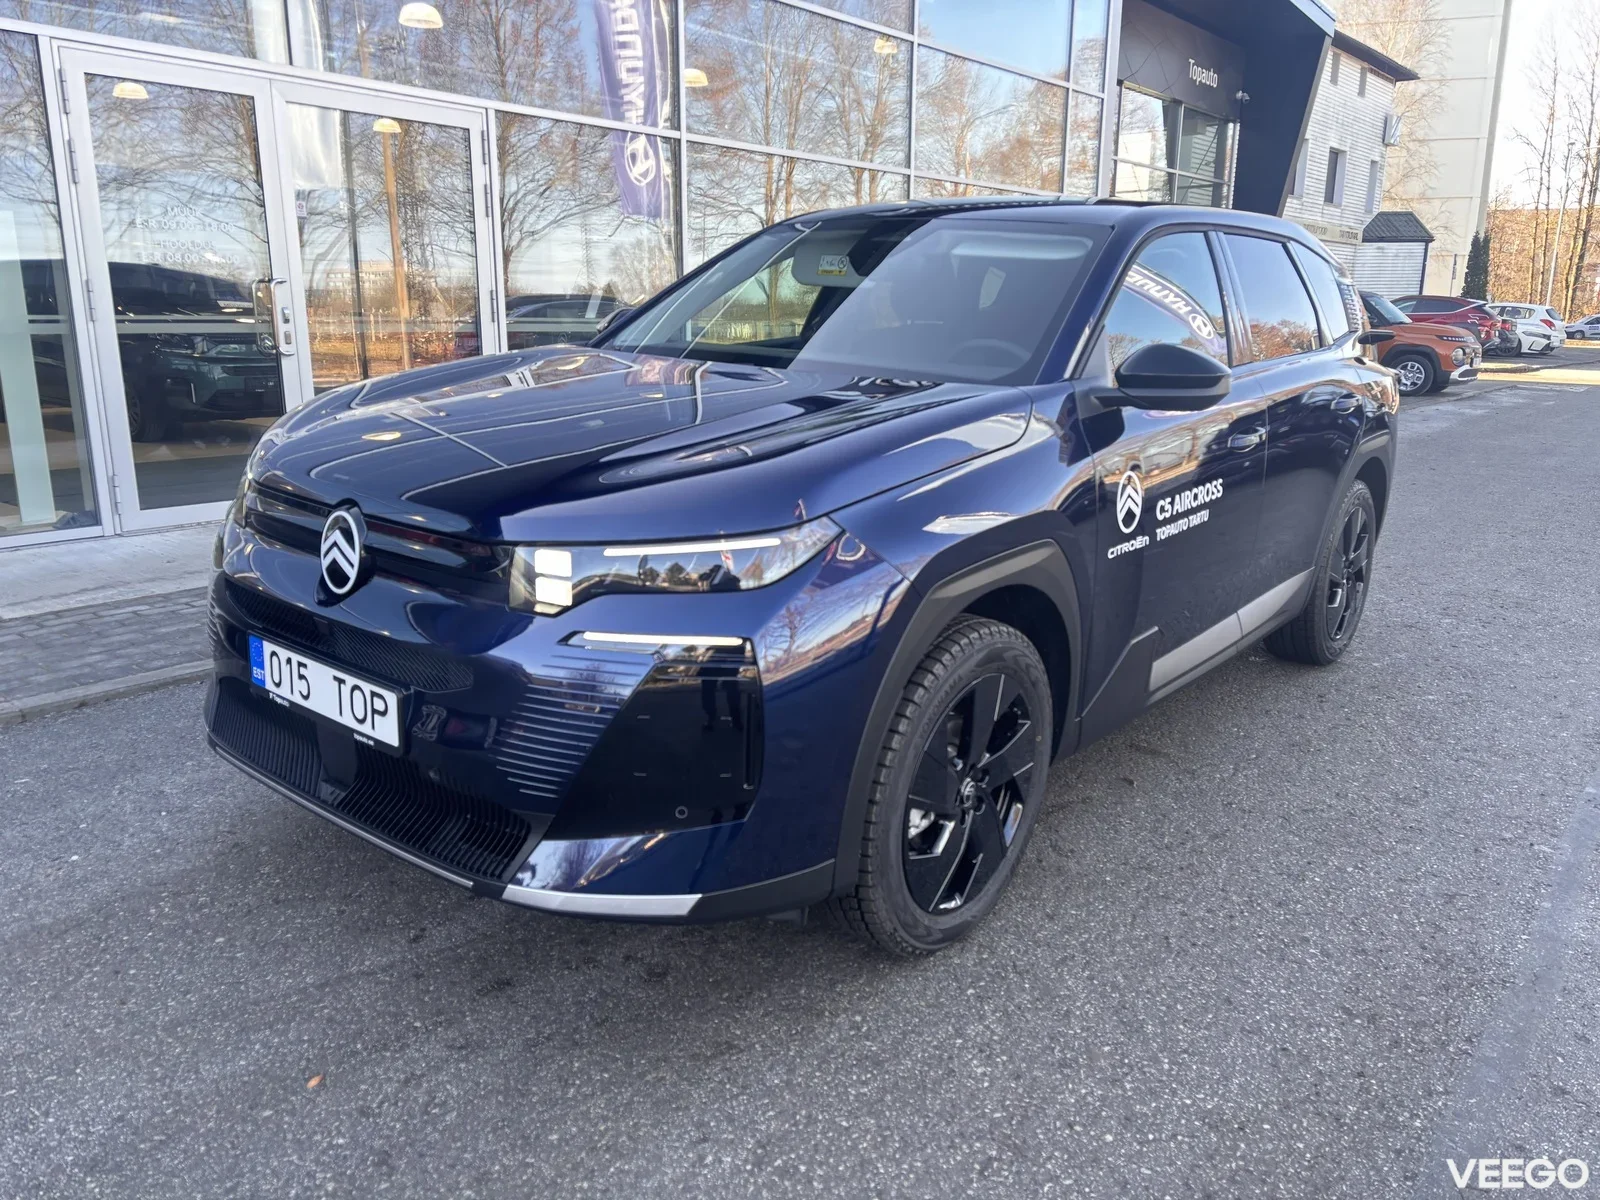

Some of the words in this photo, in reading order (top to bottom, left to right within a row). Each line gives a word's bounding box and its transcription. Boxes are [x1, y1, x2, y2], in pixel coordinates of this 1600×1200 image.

[1188, 58, 1219, 88] Topauto
[1156, 497, 1172, 521] C5
[1172, 478, 1224, 516] AIRCROSS
[1155, 517, 1189, 542] TOPAUTO
[1188, 509, 1210, 529] TARTU
[253, 667, 265, 681] EST
[269, 650, 311, 701] 015
[332, 674, 389, 732] TOP
